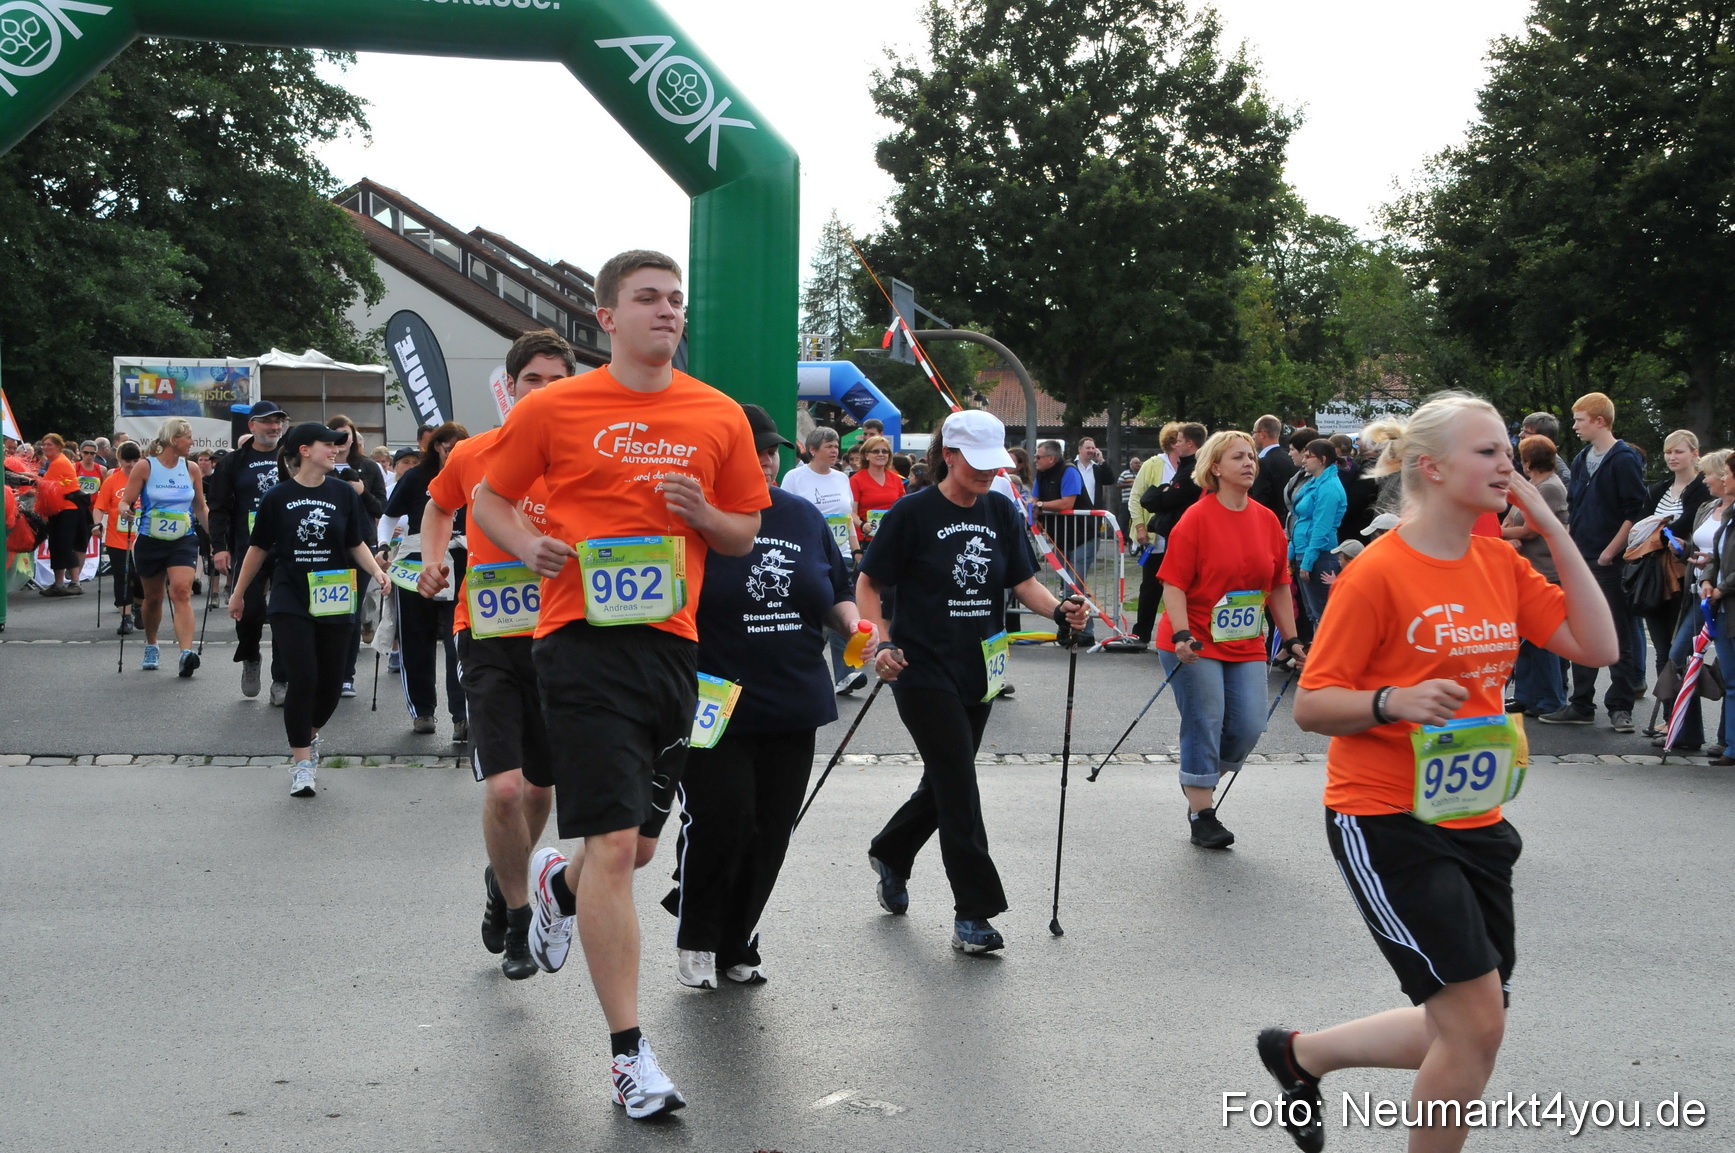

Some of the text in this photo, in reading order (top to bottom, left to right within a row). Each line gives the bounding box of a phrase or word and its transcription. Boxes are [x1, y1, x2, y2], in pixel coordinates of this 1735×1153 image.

[594, 35, 757, 172] AOK
[125, 378, 174, 394] TLA
[613, 436, 697, 457] Fischer
[248, 460, 278, 468] Chicken
[621, 456, 689, 467] AUTOMOBILE
[80, 481, 95, 490] 728
[286, 498, 337, 511] Chickenrun
[158, 520, 178, 533] 24
[832, 524, 846, 537] 12
[937, 522, 997, 540] Chickenrun
[753, 535, 802, 552] kenrun
[391, 565, 420, 582] 134
[592, 565, 664, 604] 962
[312, 585, 350, 604] 1342
[477, 583, 541, 619] 966
[603, 604, 638, 613] Andreas
[766, 600, 783, 608] der
[497, 617, 514, 625] Alex
[1216, 606, 1256, 629] 656
[747, 622, 803, 633] Heinz Müller
[1448, 641, 1518, 657] AUTOMOBILE
[1423, 751, 1498, 800] 959
